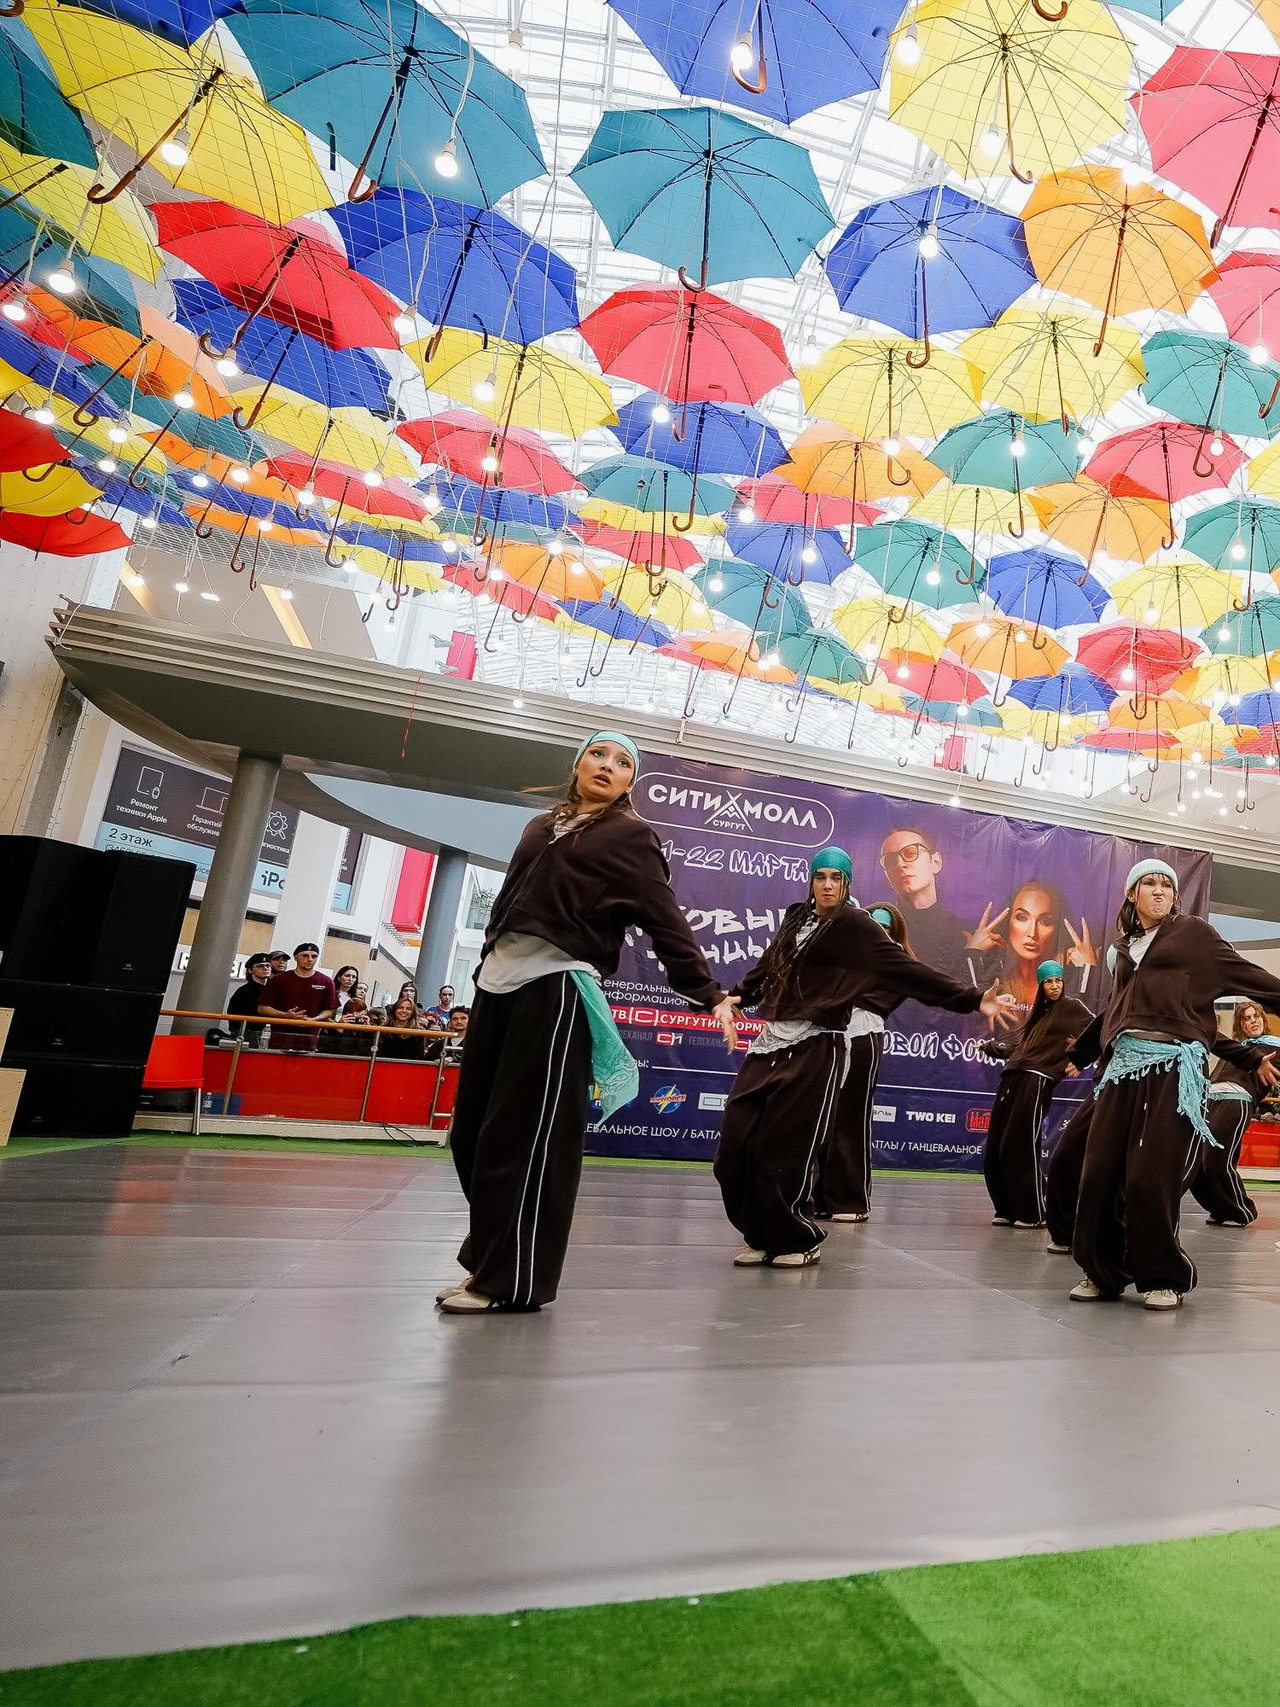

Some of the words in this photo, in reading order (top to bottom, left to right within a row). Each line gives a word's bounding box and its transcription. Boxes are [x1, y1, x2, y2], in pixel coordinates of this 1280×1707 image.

[130, 798, 159, 812] Ремонт
[648, 784, 722, 812] СИТИ
[743, 799, 818, 829] МОЛЛ
[116, 805, 147, 818] техники
[147, 812, 168, 824] Apple
[192, 814, 223, 829] Гарантий
[187, 823, 220, 837] обслужив
[712, 819, 746, 831] СУРГУТ
[109, 827, 118, 839] 2
[120, 832, 153, 848] этаж
[262, 842, 290, 854] гностика
[661, 839, 725, 871] 1-22
[729, 849, 810, 883] МАРТА
[680, 906, 786, 935] ОВЫ
[603, 979, 676, 995] енеральны
[602, 990, 689, 1007] нформацион
[612, 1008, 627, 1020] ТВ
[660, 1013, 766, 1033] СУРГУТИНОРМ
[619, 1029, 653, 1042] ЛЕКАНАЛ
[883, 1030, 939, 1059] ОВОЙ
[905, 1110, 934, 1122] TWO
[936, 1113, 956, 1124] KEI
[584, 1122, 648, 1136] ЕВАЛЬНОЕ
[650, 1126, 680, 1138] ШОУ
[690, 1129, 722, 1140] БАТТЛ
[908, 1142, 983, 1155] ТАНЦЕВАЛЬНОЕ
